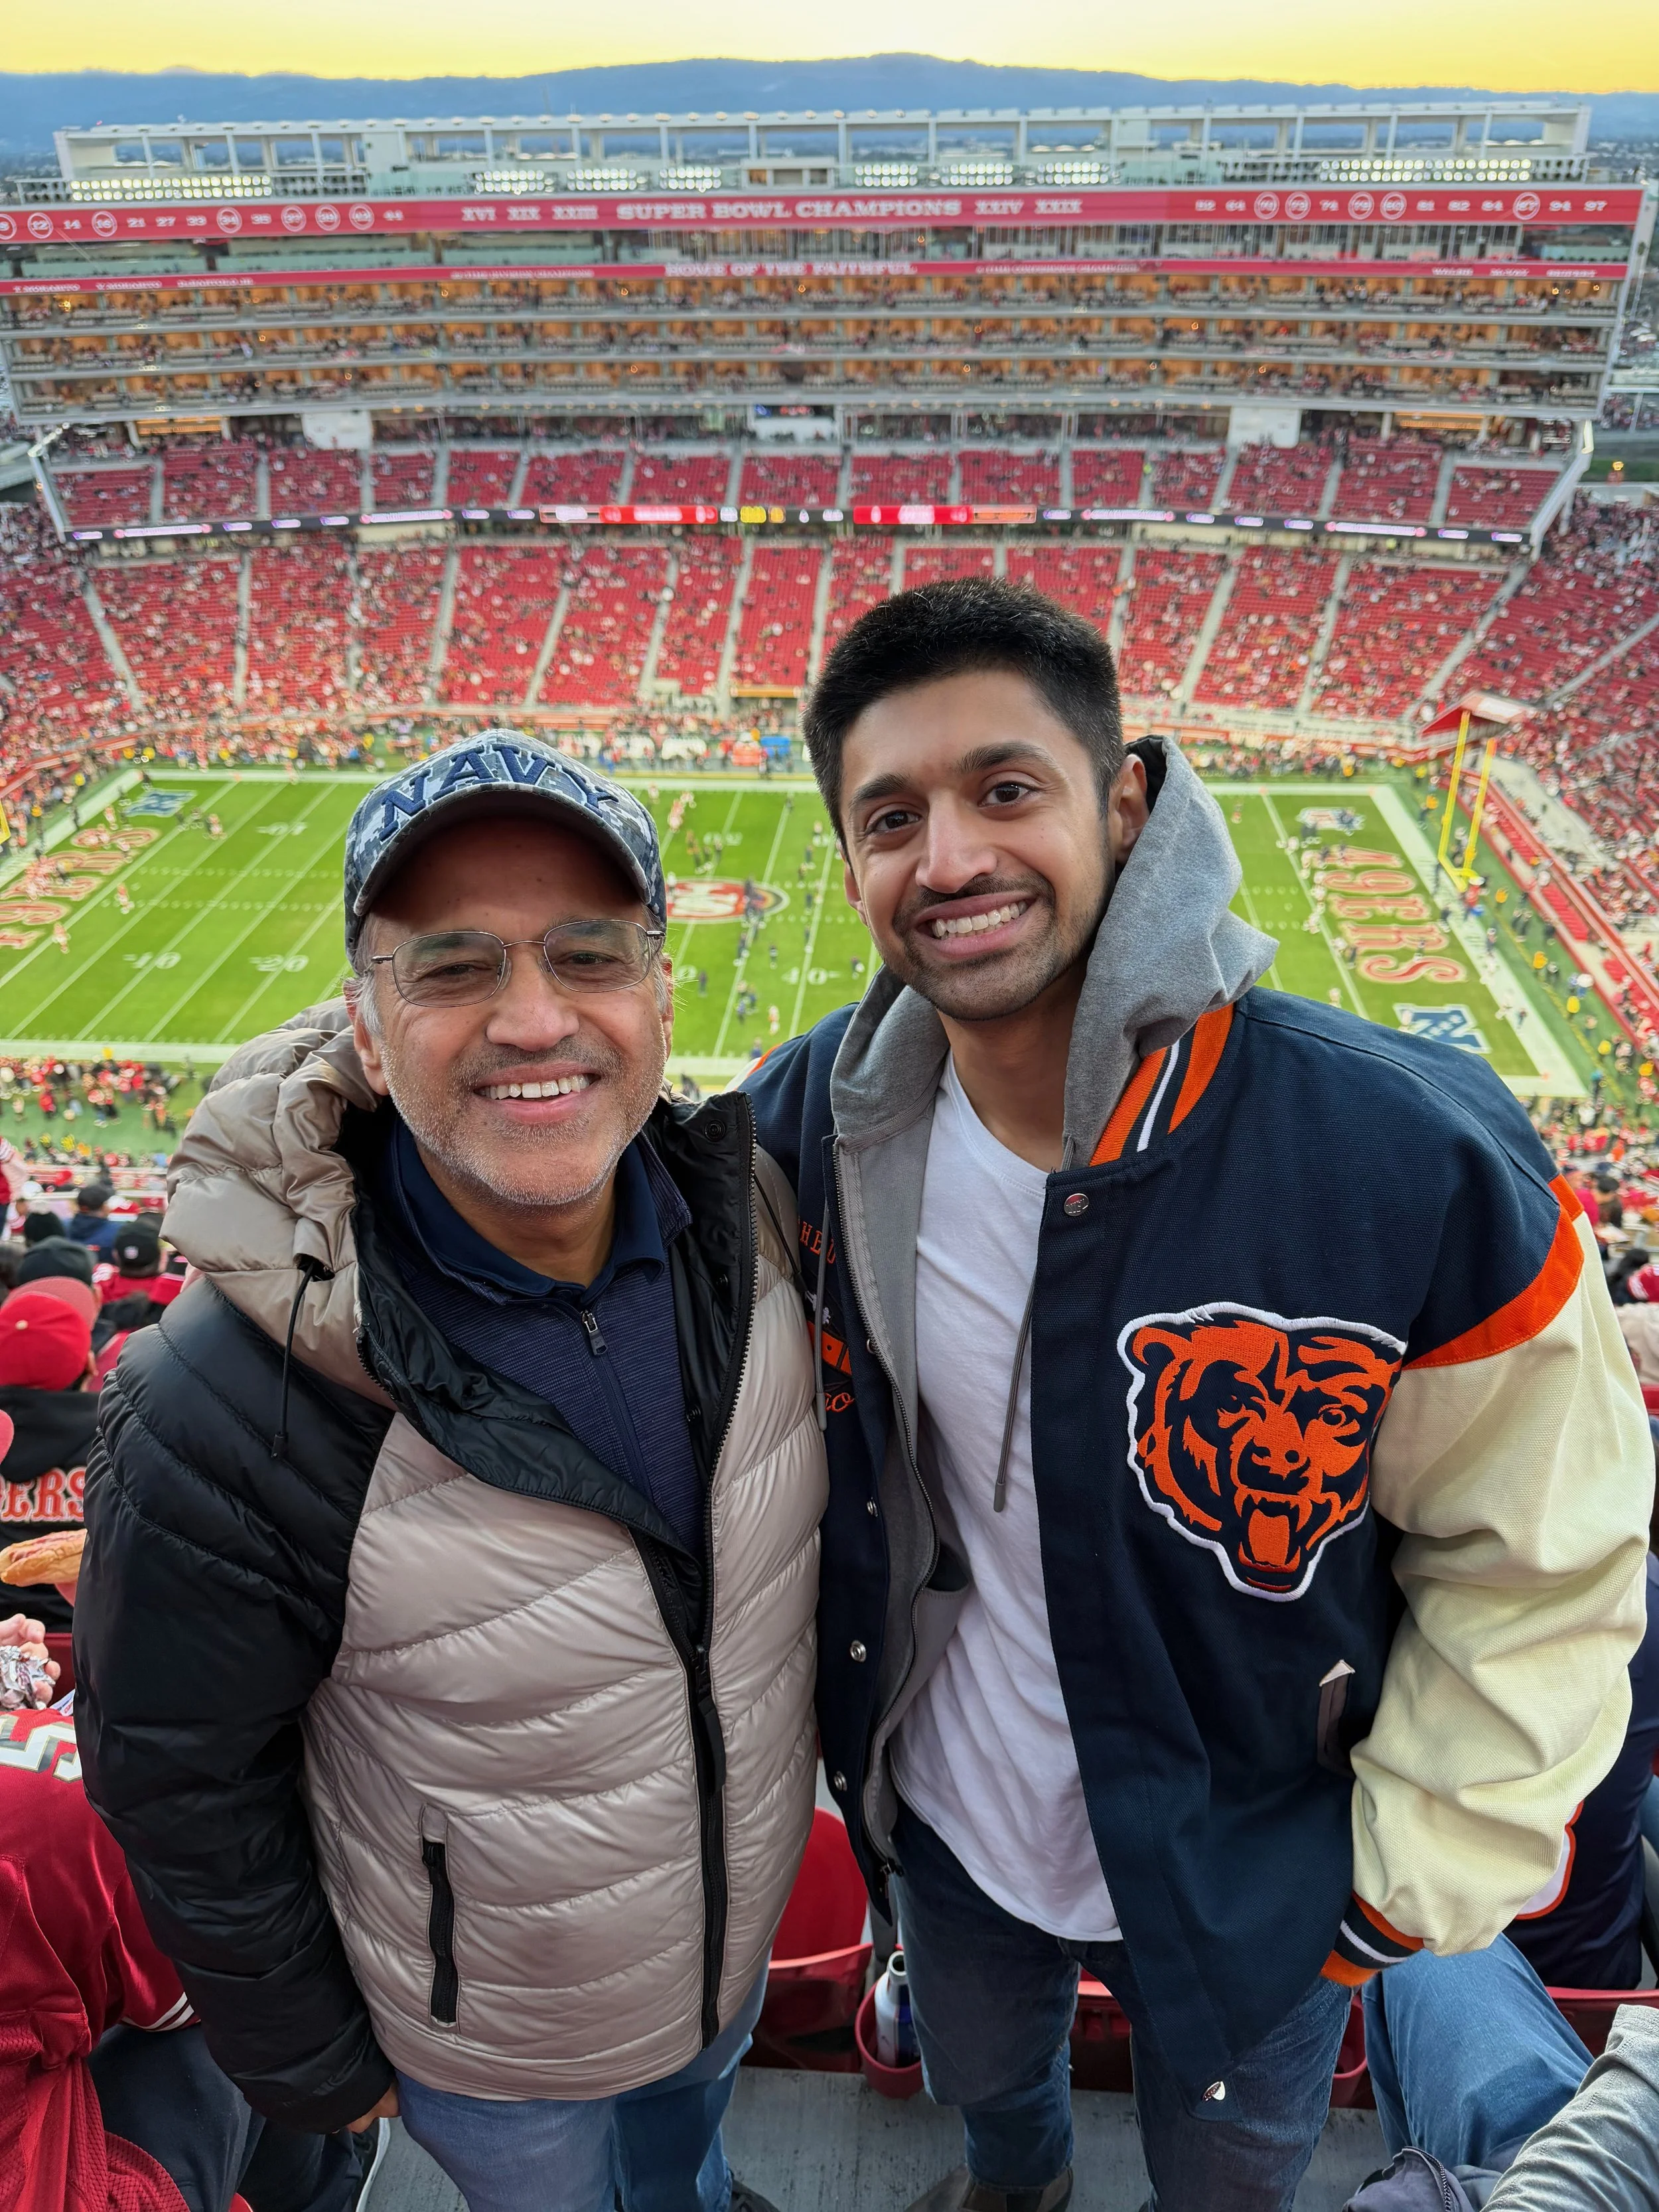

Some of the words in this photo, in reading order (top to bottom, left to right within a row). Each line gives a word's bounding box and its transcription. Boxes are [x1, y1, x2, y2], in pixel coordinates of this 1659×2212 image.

[462, 206, 496, 221] XVI
[507, 206, 540, 220] XIX
[617, 202, 706, 220] SUPER
[712, 201, 791, 219] BOWL
[796, 200, 961, 218] CHAMPIONS
[975, 199, 1024, 214] XXIV
[1035, 198, 1083, 214] XXIX
[1516, 200, 1538, 212] 87
[1550, 200, 1572, 212] 94
[1584, 200, 1607, 212] 97
[32, 221, 48, 230] 12
[64, 220, 82, 229] 14
[96, 219, 112, 228] 16
[127, 218, 146, 228] 21
[156, 216, 176, 226] 27
[186, 216, 206, 226] 33
[665, 263, 727, 277] HOME
[731, 263, 758, 276] OF
[762, 262, 806, 276] THE
[812, 261, 918, 275] FAITHFUL
[379, 743, 620, 842] NAVY
